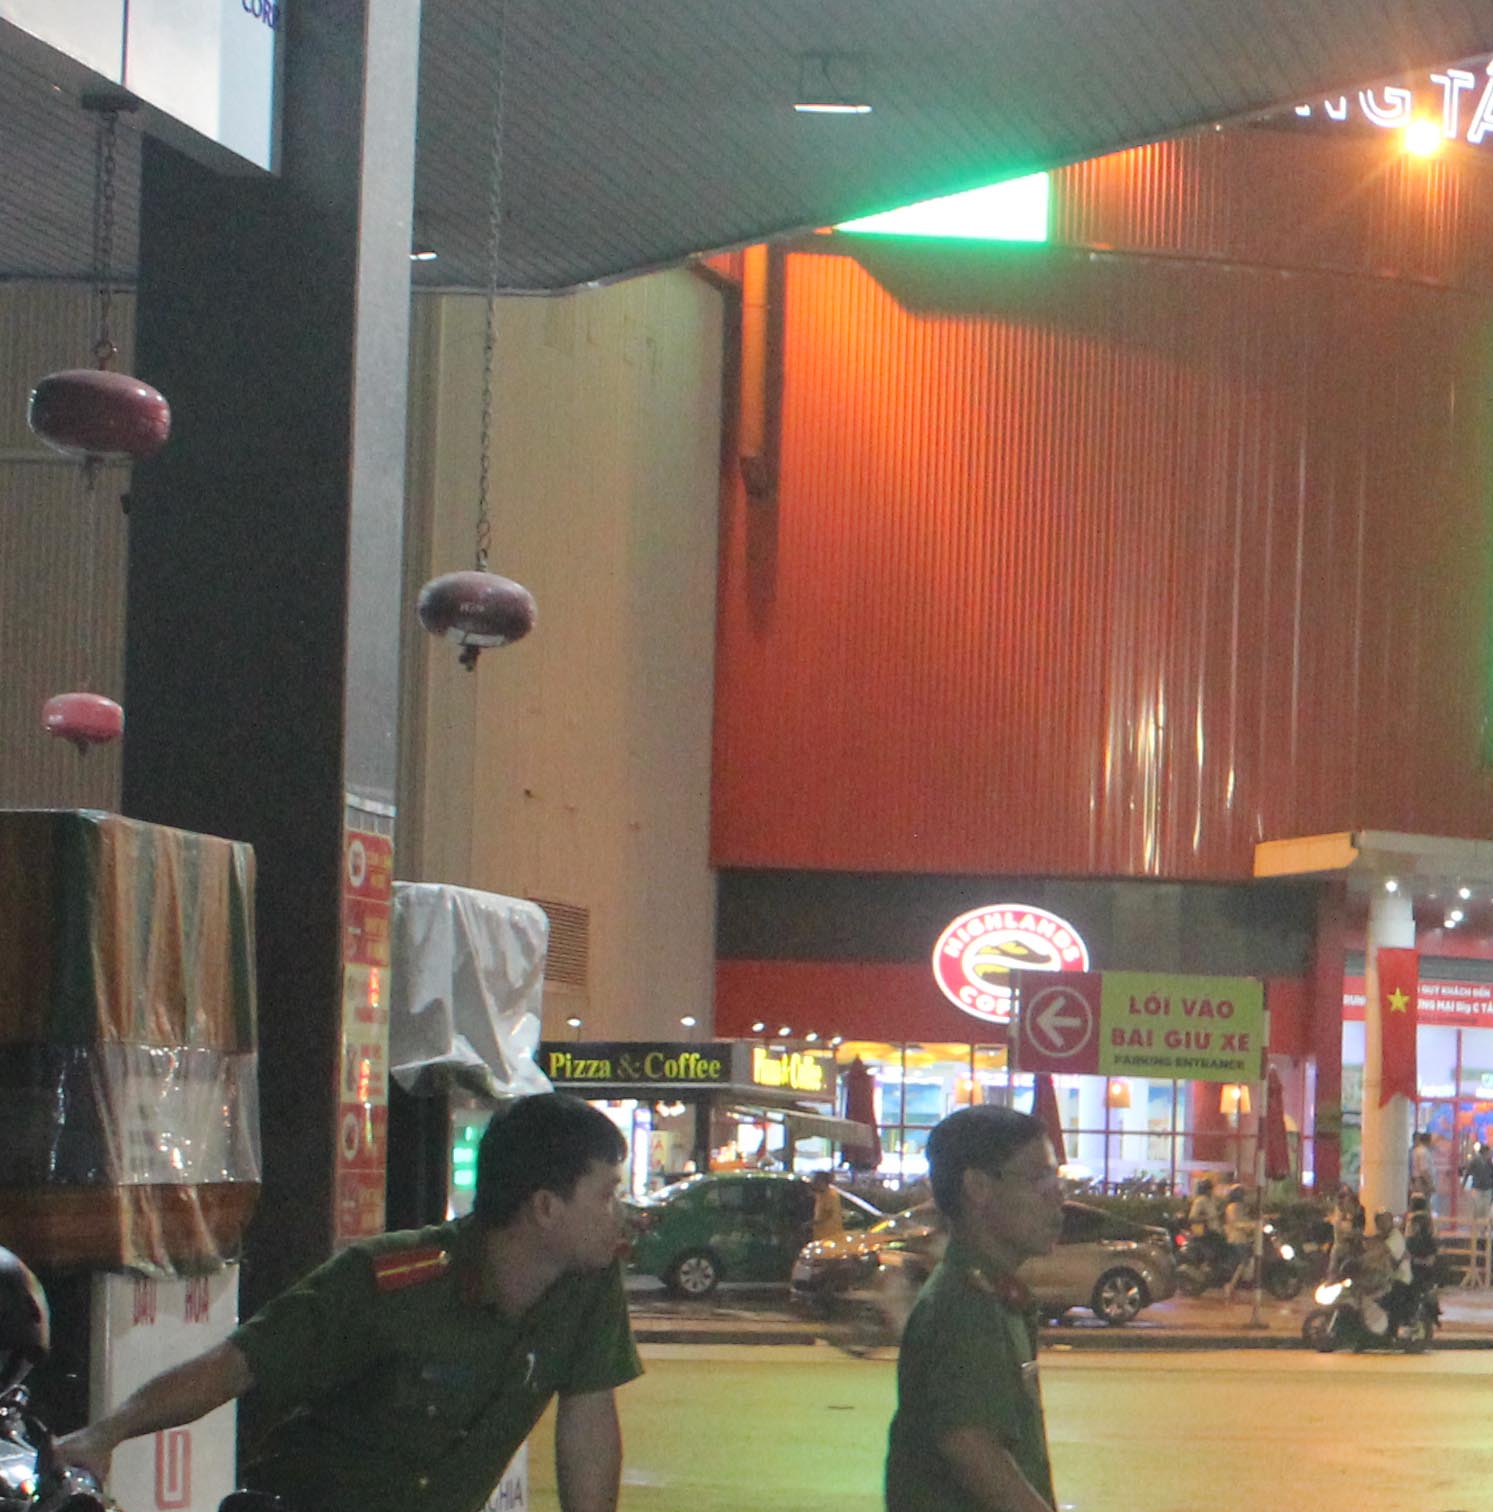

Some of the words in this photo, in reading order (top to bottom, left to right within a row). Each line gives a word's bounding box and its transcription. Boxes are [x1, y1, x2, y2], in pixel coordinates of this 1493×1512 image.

[944, 910, 1081, 963] HIGHLANDS
[1220, 1032, 1251, 1052] XE
[549, 1051, 612, 1078] Pizza
[617, 1054, 641, 1079] &
[644, 1051, 721, 1079] Coffee
